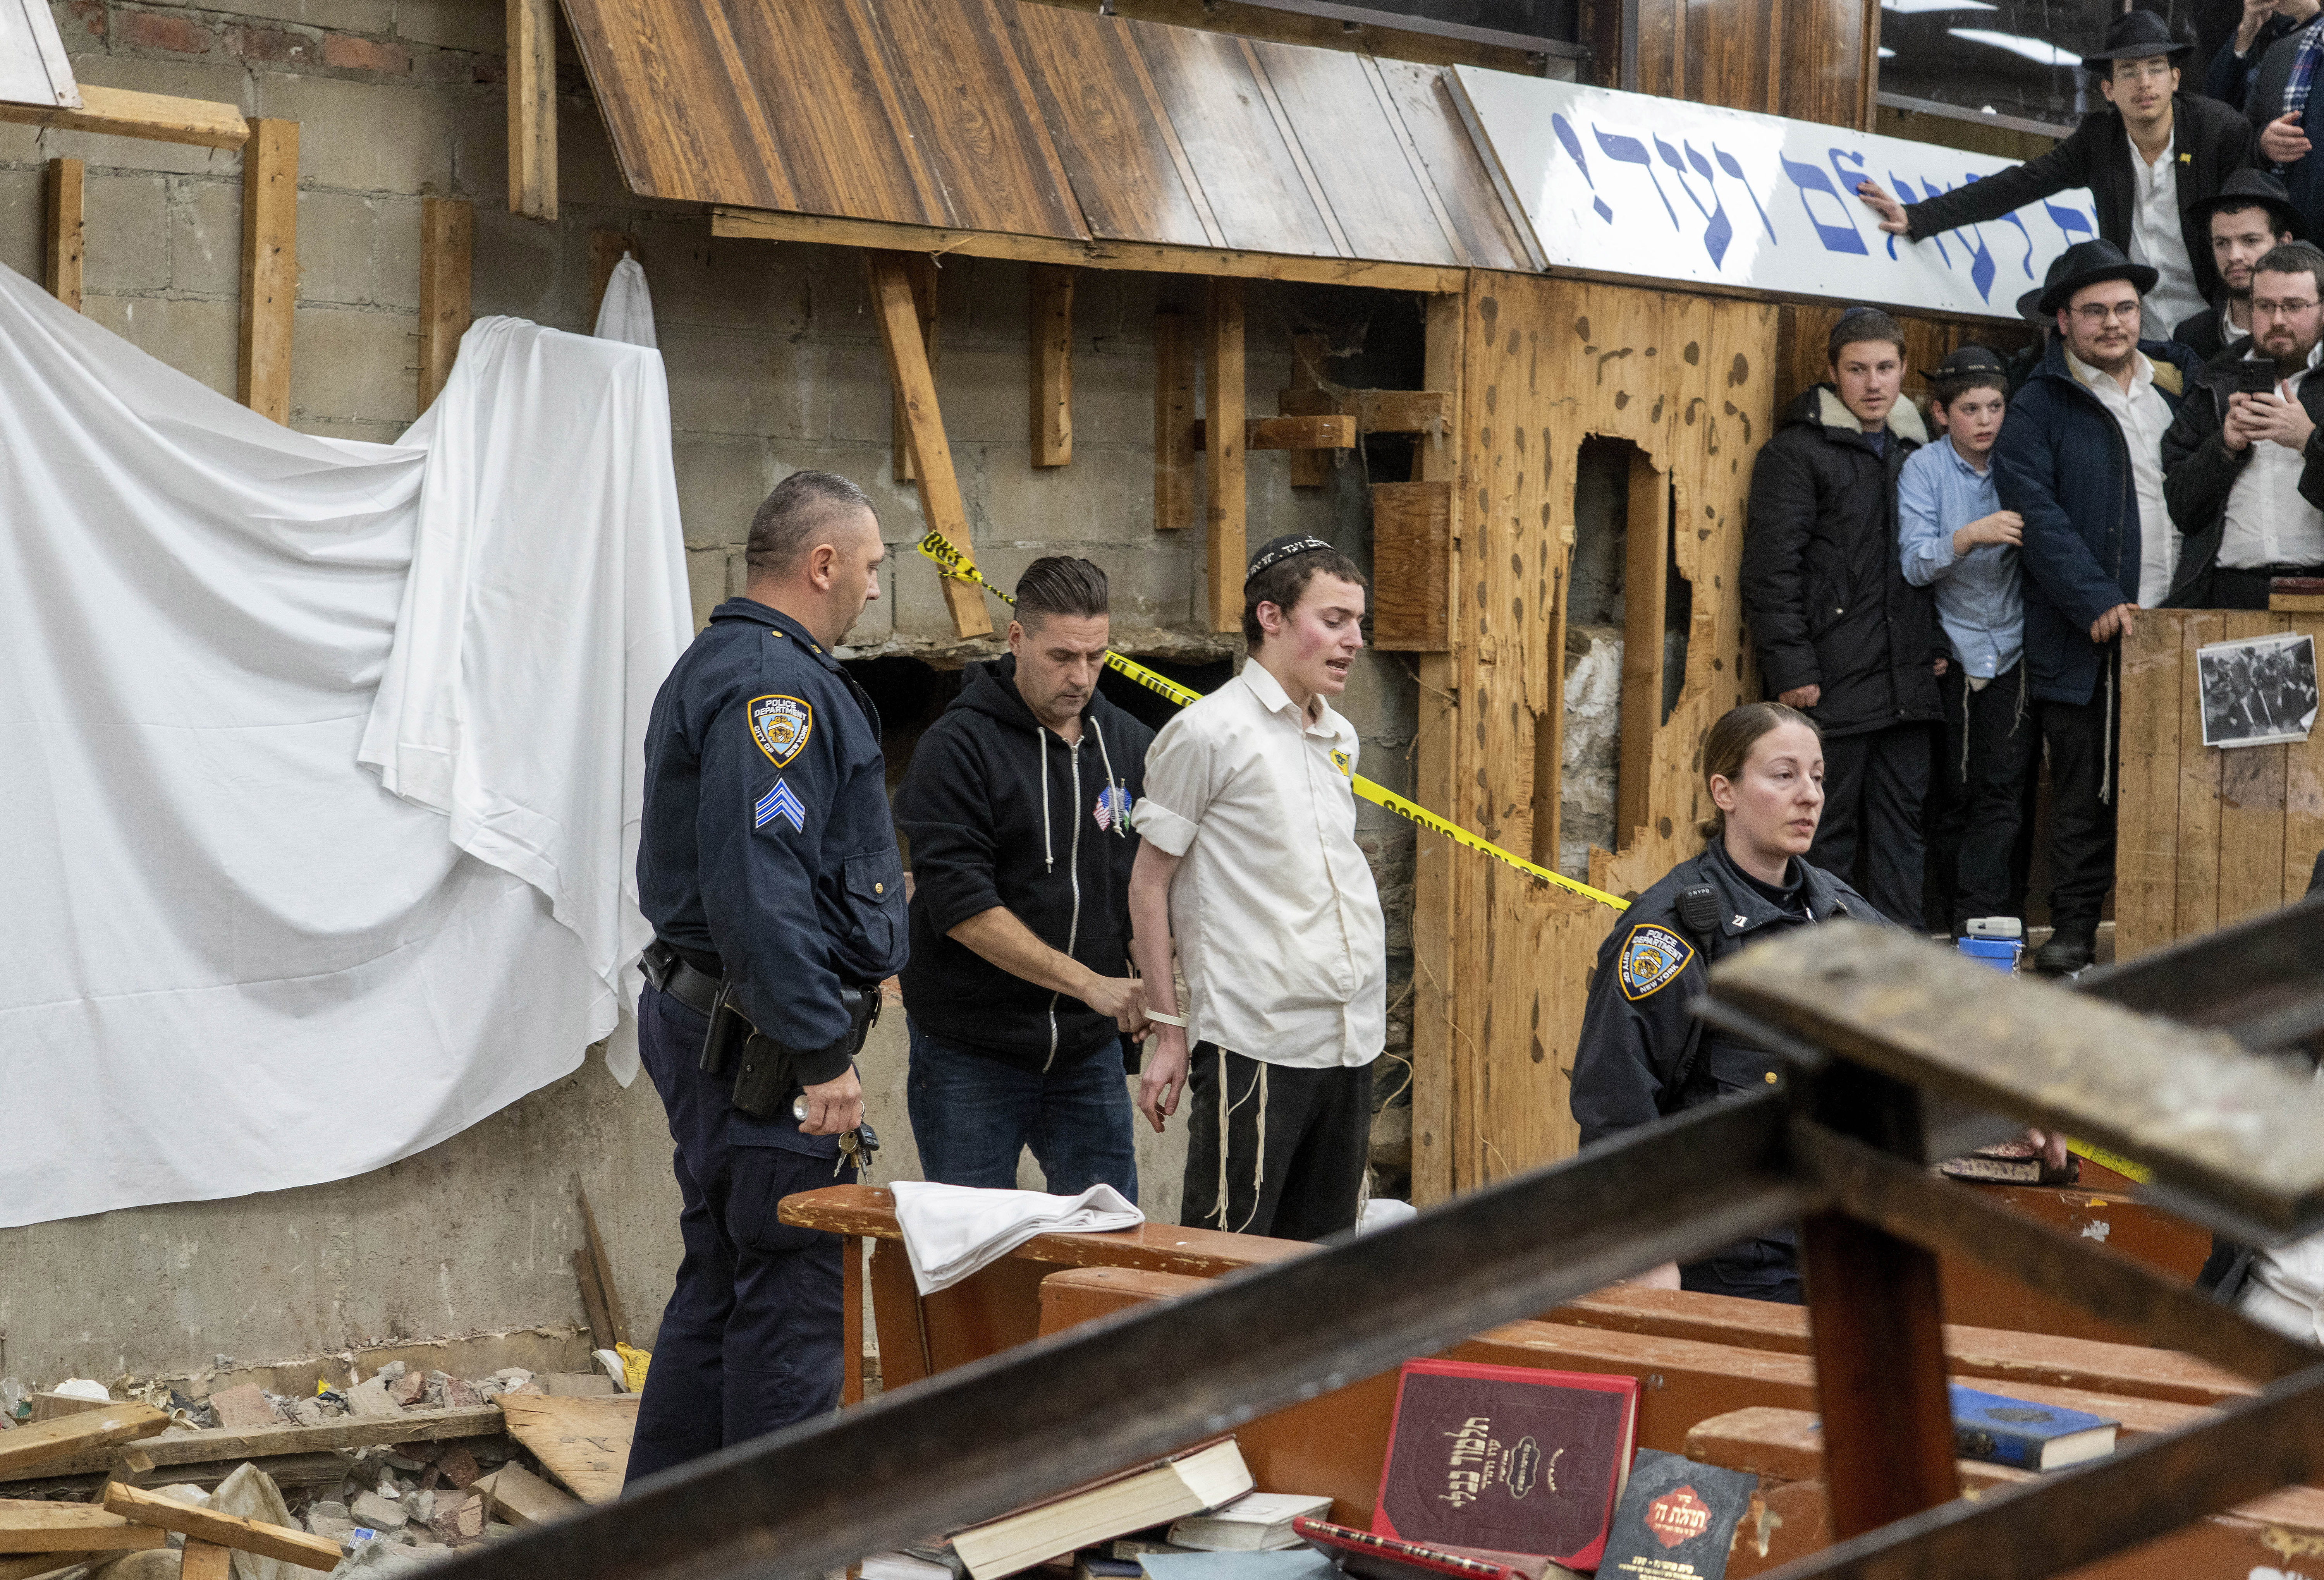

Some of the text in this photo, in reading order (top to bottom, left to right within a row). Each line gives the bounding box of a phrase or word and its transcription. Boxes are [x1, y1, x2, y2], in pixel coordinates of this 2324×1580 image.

[1552, 113, 1777, 271] ועד!
[754, 706, 807, 721] DEPARTMENT
[765, 699, 796, 709] POLICE
[754, 725, 775, 753] CITY OF
[784, 725, 808, 757] NEW YORK
[1632, 936, 1684, 961] DEPARTMENT
[1646, 929, 1678, 947] POLICE
[1623, 971, 1631, 983] OF
[1639, 964, 1679, 993] NEW YORK
[1438, 1417, 1490, 1507] תלמוד בבלי
